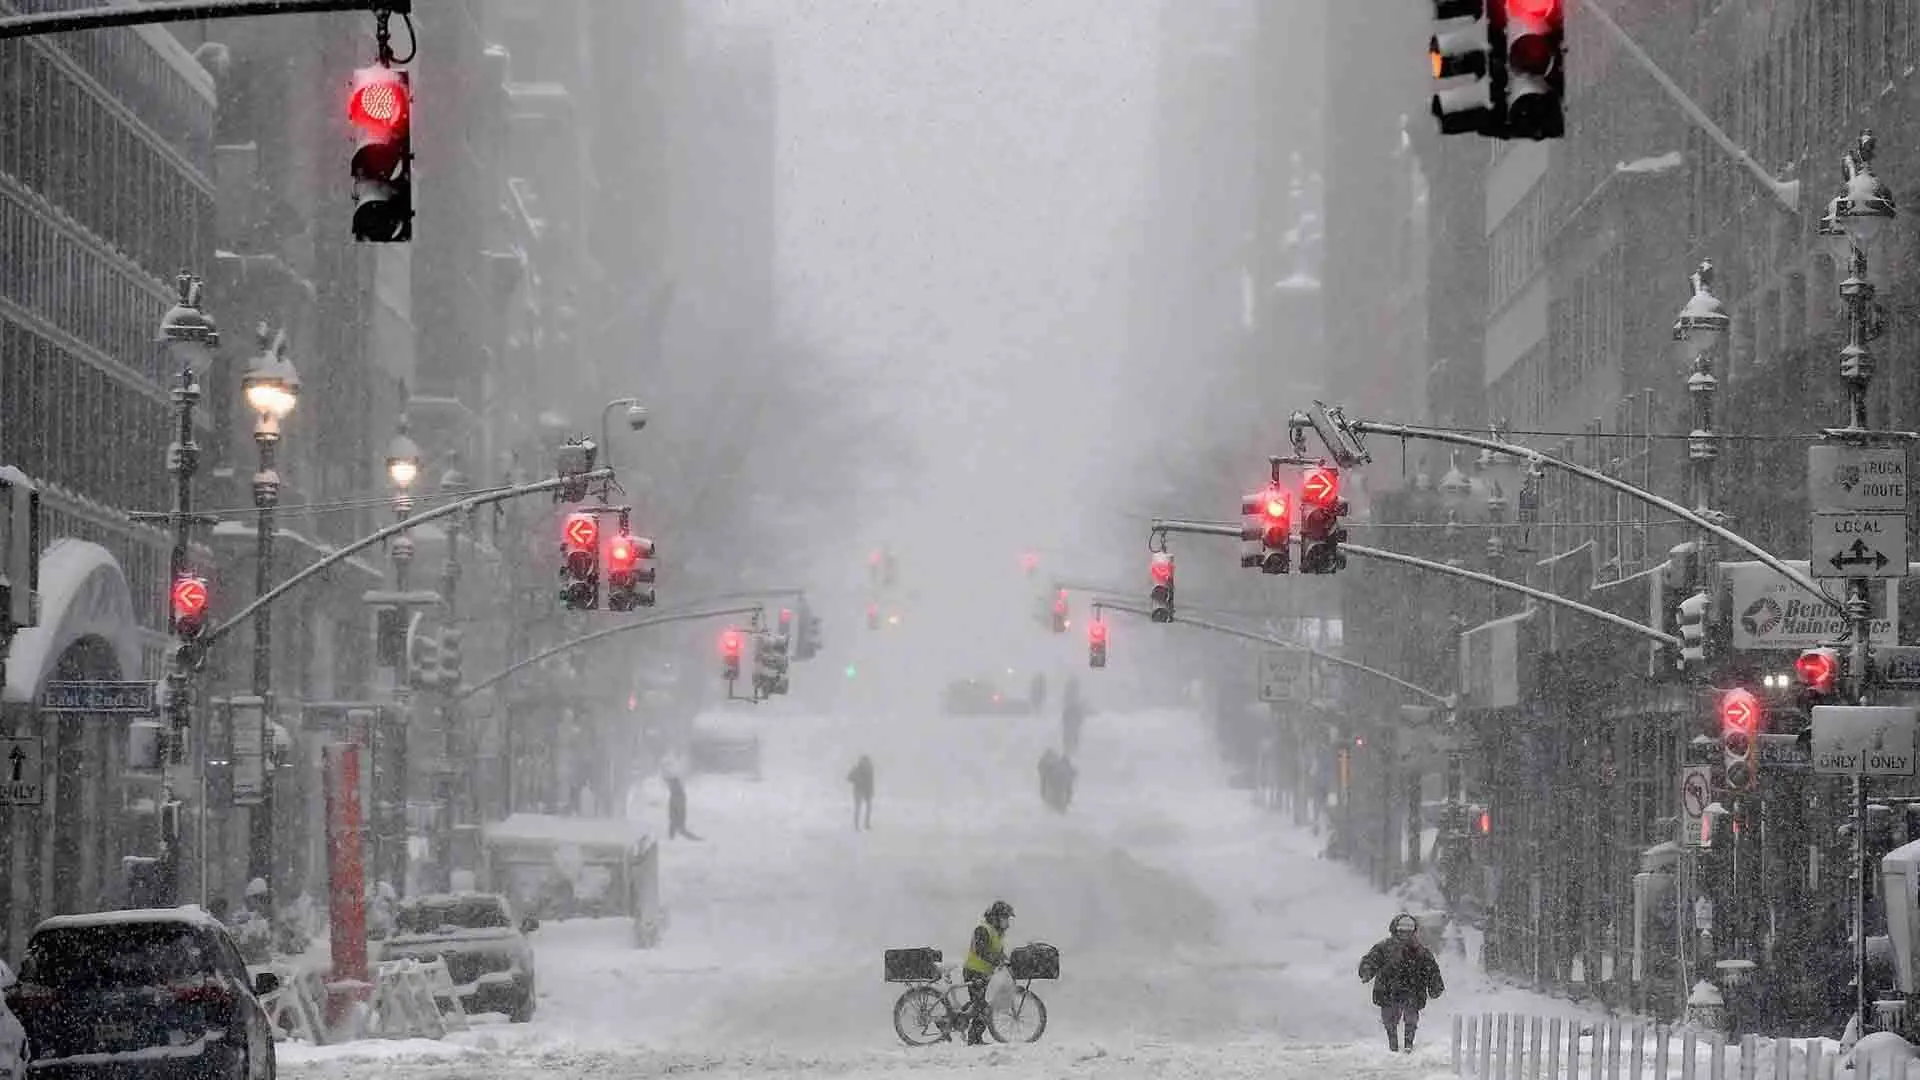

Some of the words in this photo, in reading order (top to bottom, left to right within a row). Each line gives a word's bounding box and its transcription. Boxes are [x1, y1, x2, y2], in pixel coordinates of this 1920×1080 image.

[1863, 461, 1903, 474] TRUCK
[1863, 483, 1905, 497] ROUTE
[1834, 520, 1882, 533] LOCAL
[1820, 755, 1857, 769] ONLY
[1871, 755, 1907, 769] ONLY
